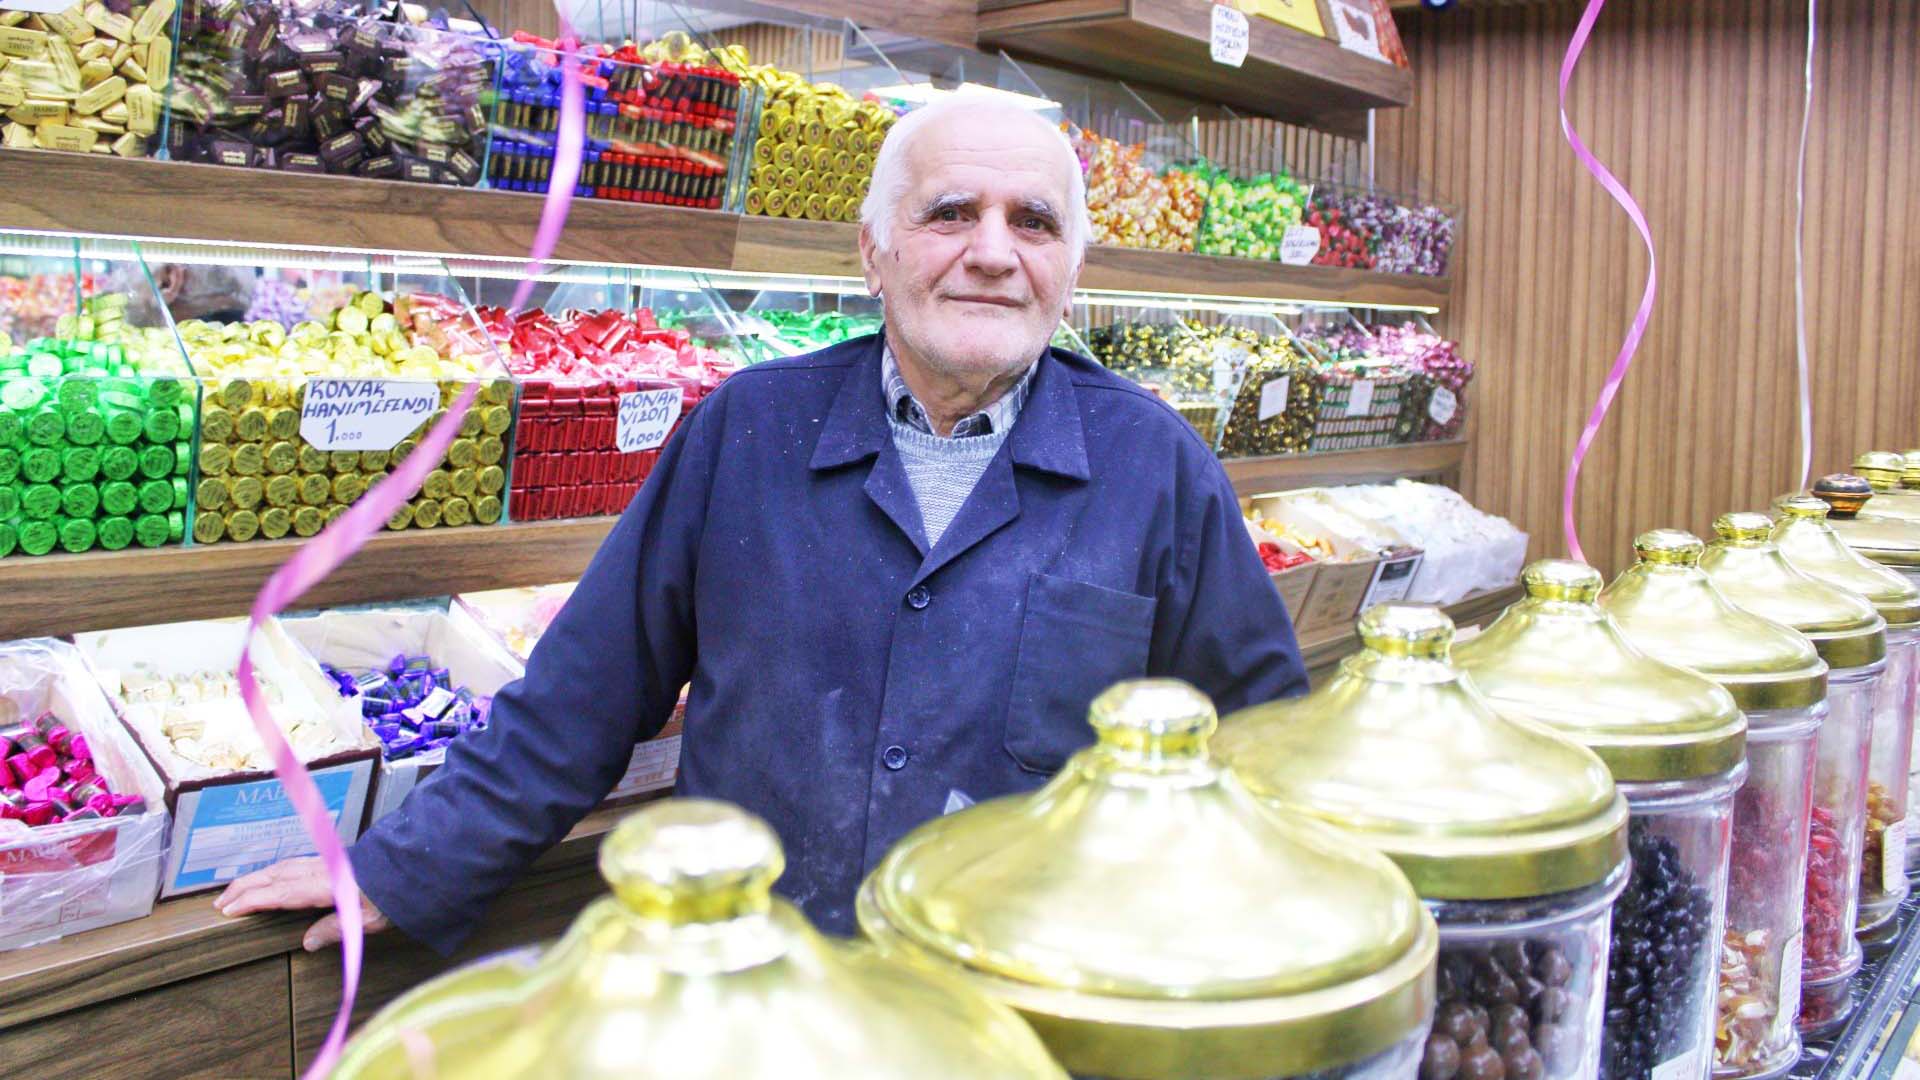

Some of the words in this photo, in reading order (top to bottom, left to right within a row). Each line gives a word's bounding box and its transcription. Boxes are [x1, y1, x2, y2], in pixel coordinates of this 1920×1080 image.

[309, 380, 385, 399] KONAK
[620, 391, 678, 410] KONAK
[325, 418, 363, 444] 1.000
[622, 427, 664, 448] 1.000
